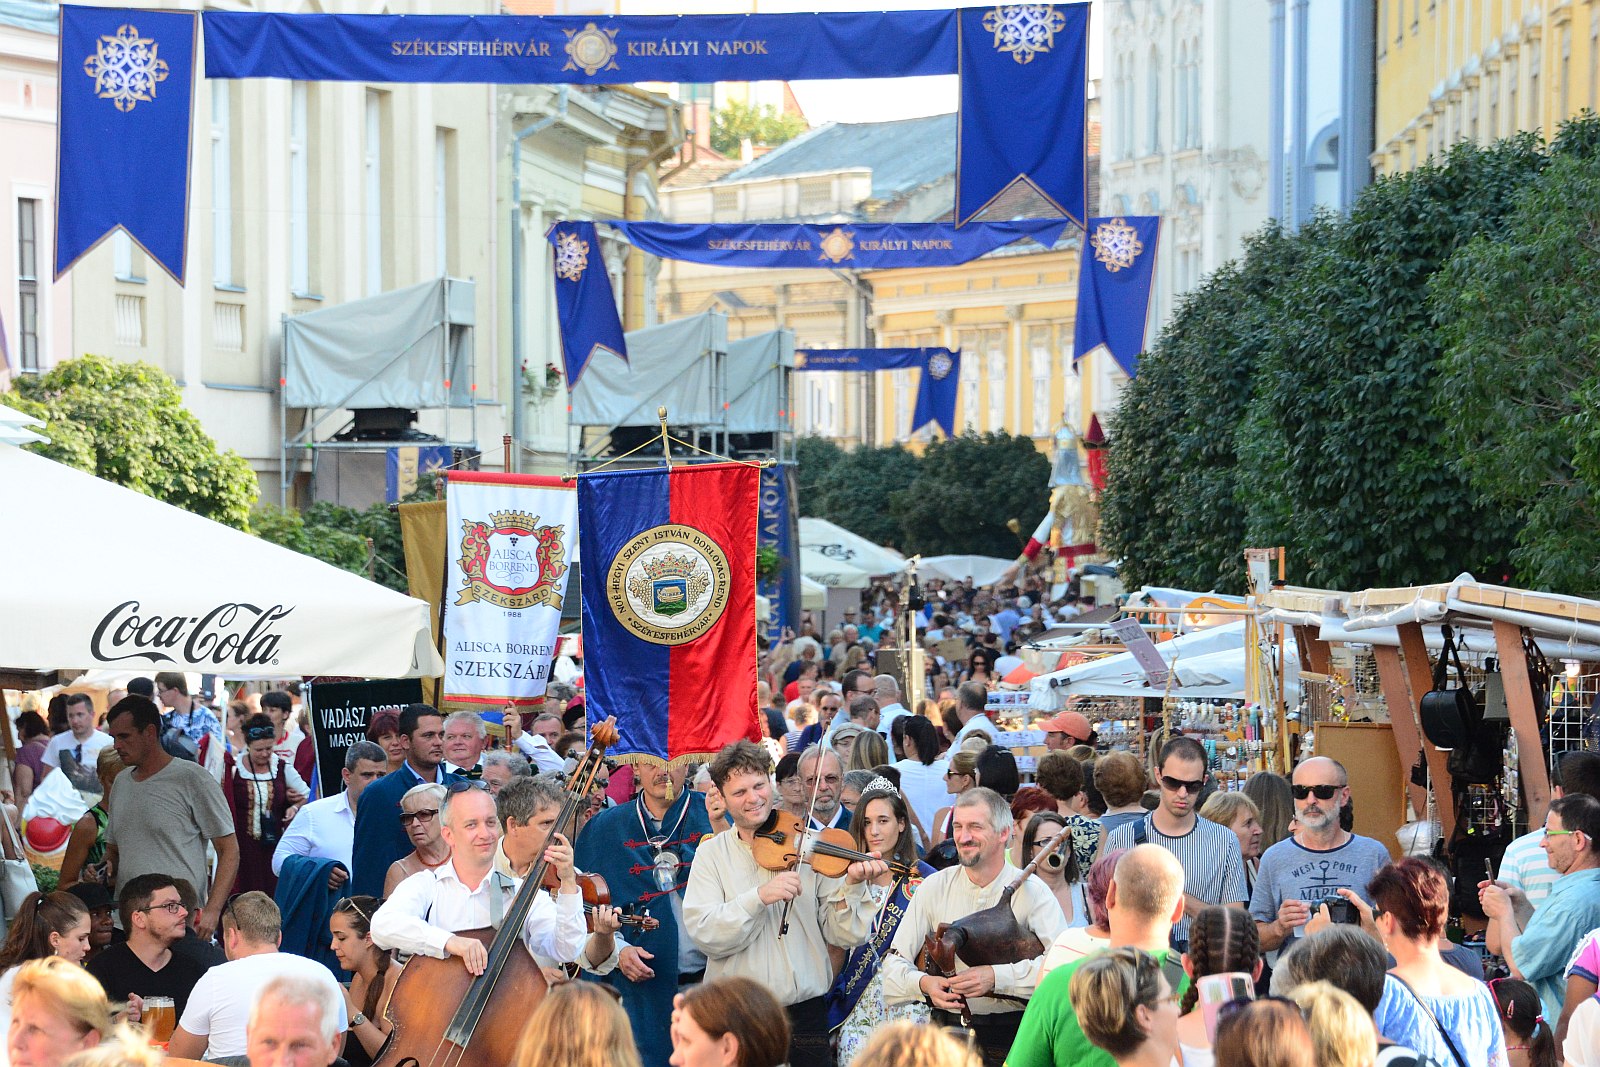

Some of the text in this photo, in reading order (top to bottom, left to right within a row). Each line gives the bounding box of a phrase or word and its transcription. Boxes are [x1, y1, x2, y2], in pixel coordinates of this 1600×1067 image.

[391, 38, 768, 57] SZÉKESFEHÉRVÁR KIRÁLYI NAPOK
[708, 239, 953, 251] SZÉKESFEHÉRVÁR KIRÁLYI NAPOK
[492, 549, 533, 561] ALISCA
[489, 560, 538, 573] BORREND
[612, 528, 727, 614] NOÉ-HEGYI SZENT ISTVÁN BORLOVAGREND
[473, 585, 549, 606] SZEKSZÁRD
[90, 600, 296, 665] Coca-Cola
[631, 616, 711, 640] SZÉKESFEHÉRVÁR
[455, 641, 553, 656] ALISCA BORREN
[320, 700, 366, 729] VADÁSZ
[329, 732, 367, 748] MAGYA
[1291, 861, 1358, 878] WEST PORT
[886, 902, 904, 918] 201
